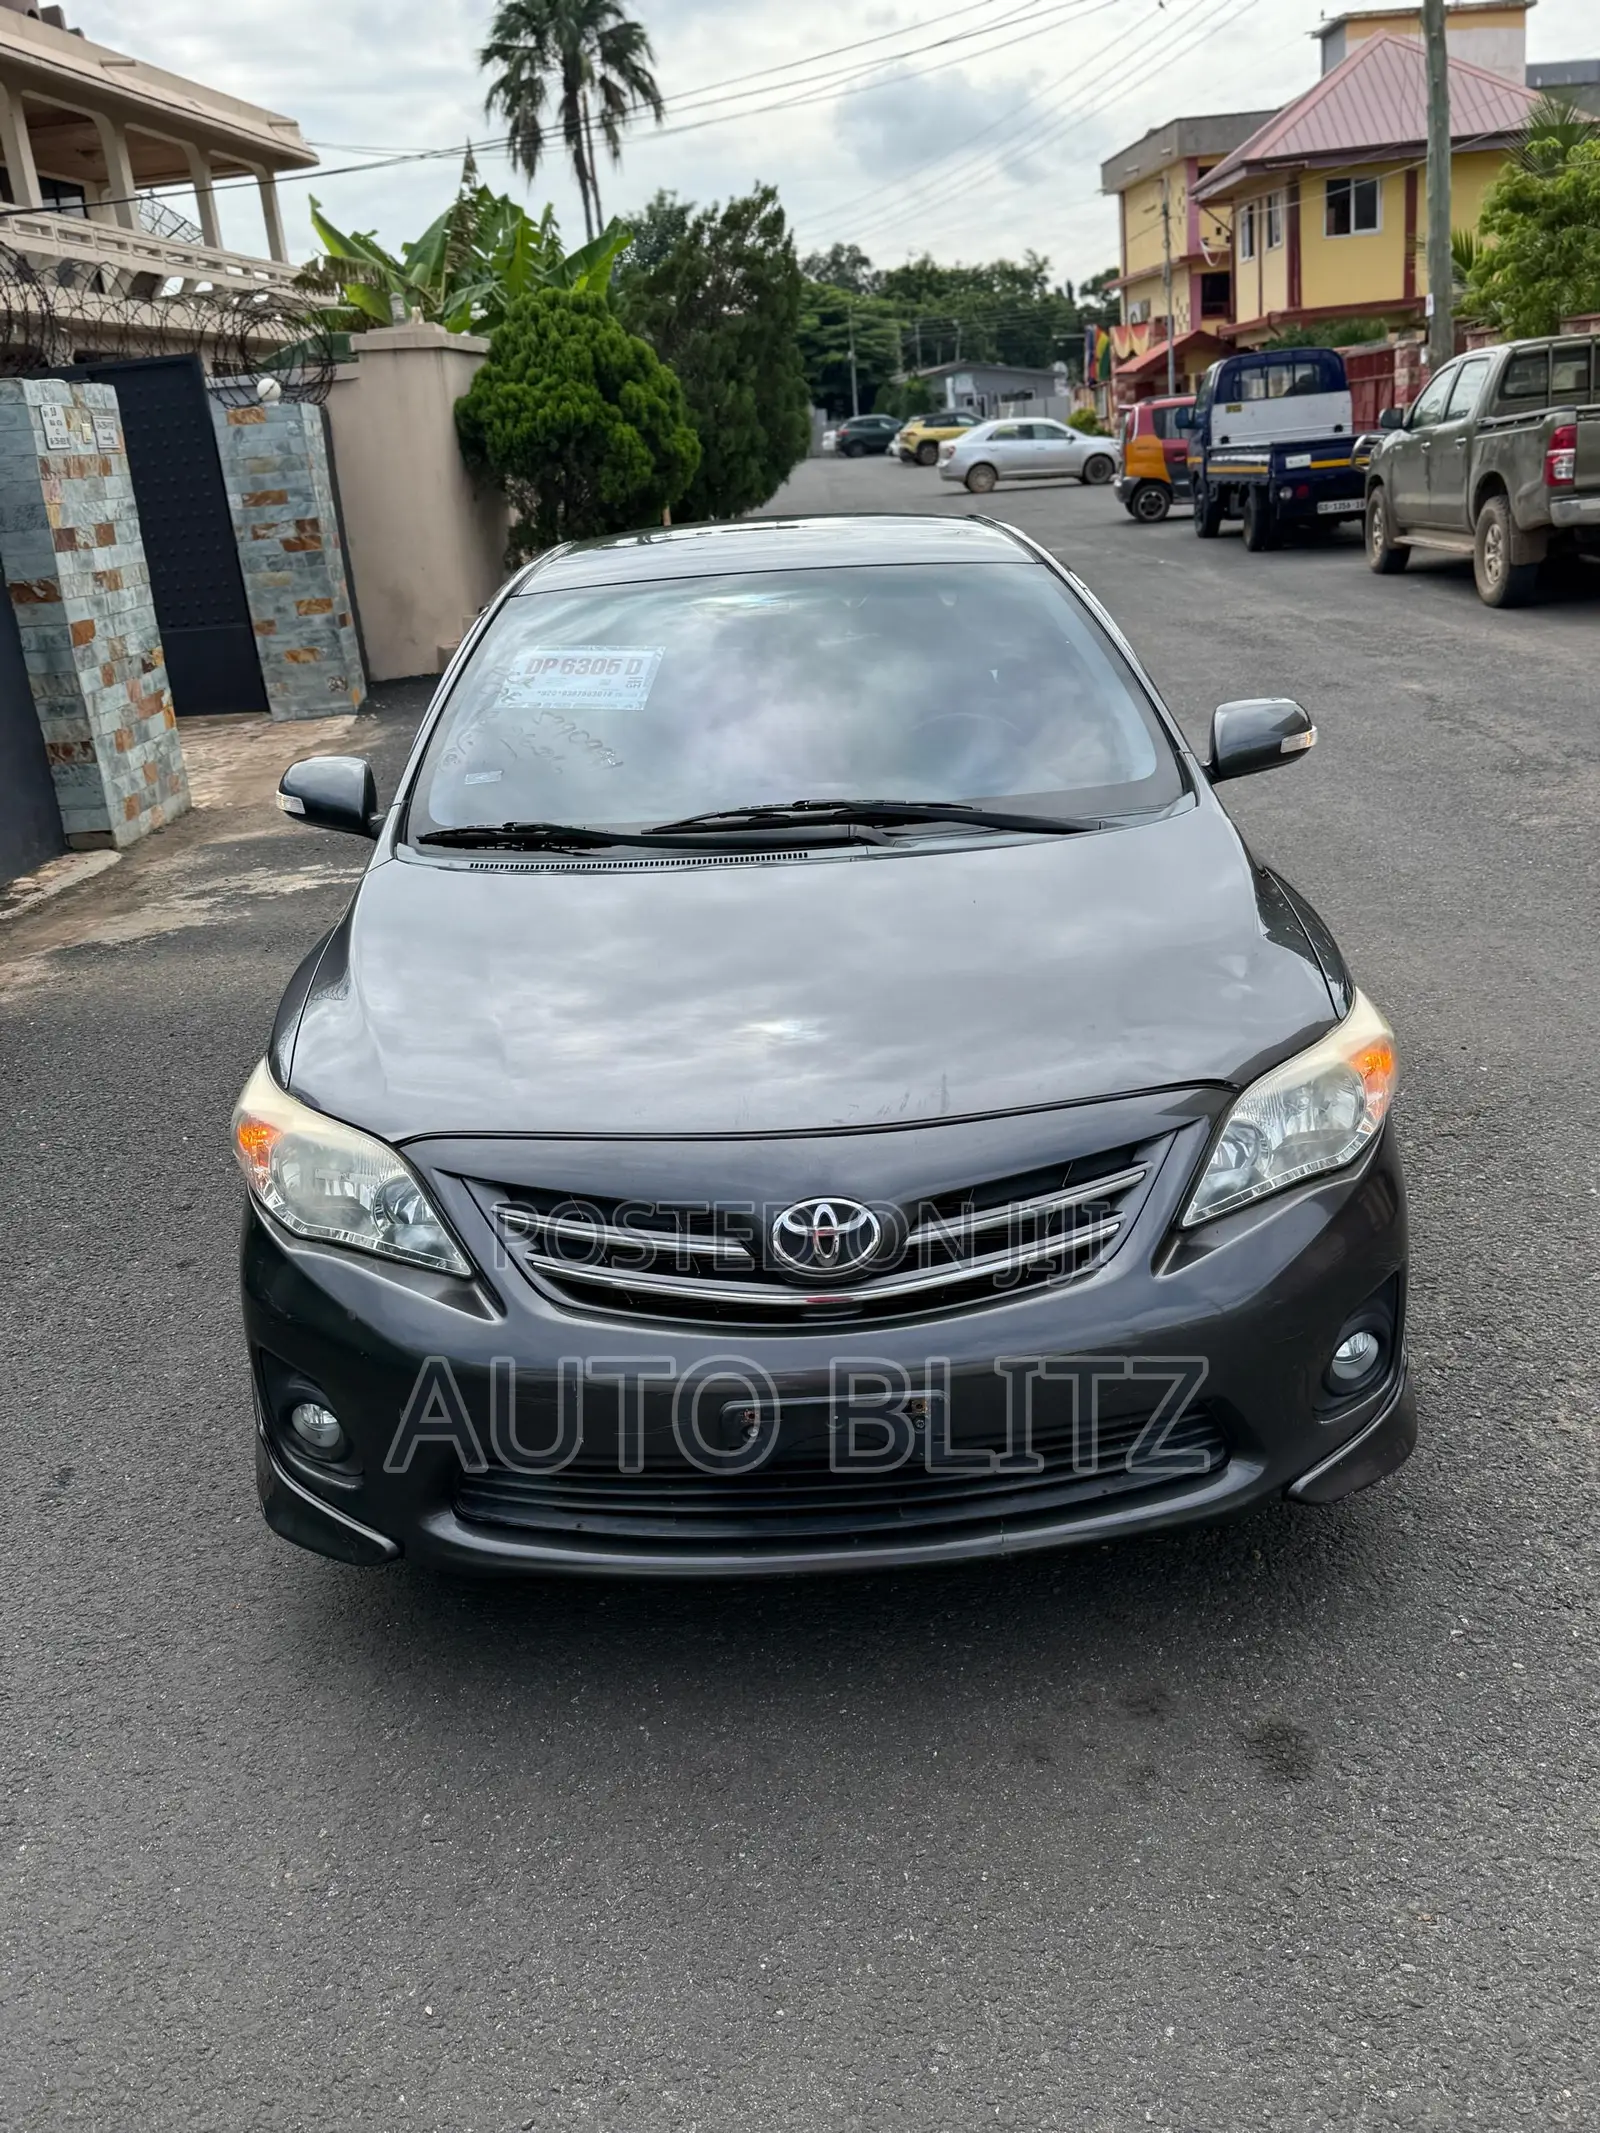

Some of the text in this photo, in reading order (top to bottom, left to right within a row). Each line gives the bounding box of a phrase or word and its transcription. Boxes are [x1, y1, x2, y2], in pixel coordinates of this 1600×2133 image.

[524, 658, 643, 676] DP 6305 D
